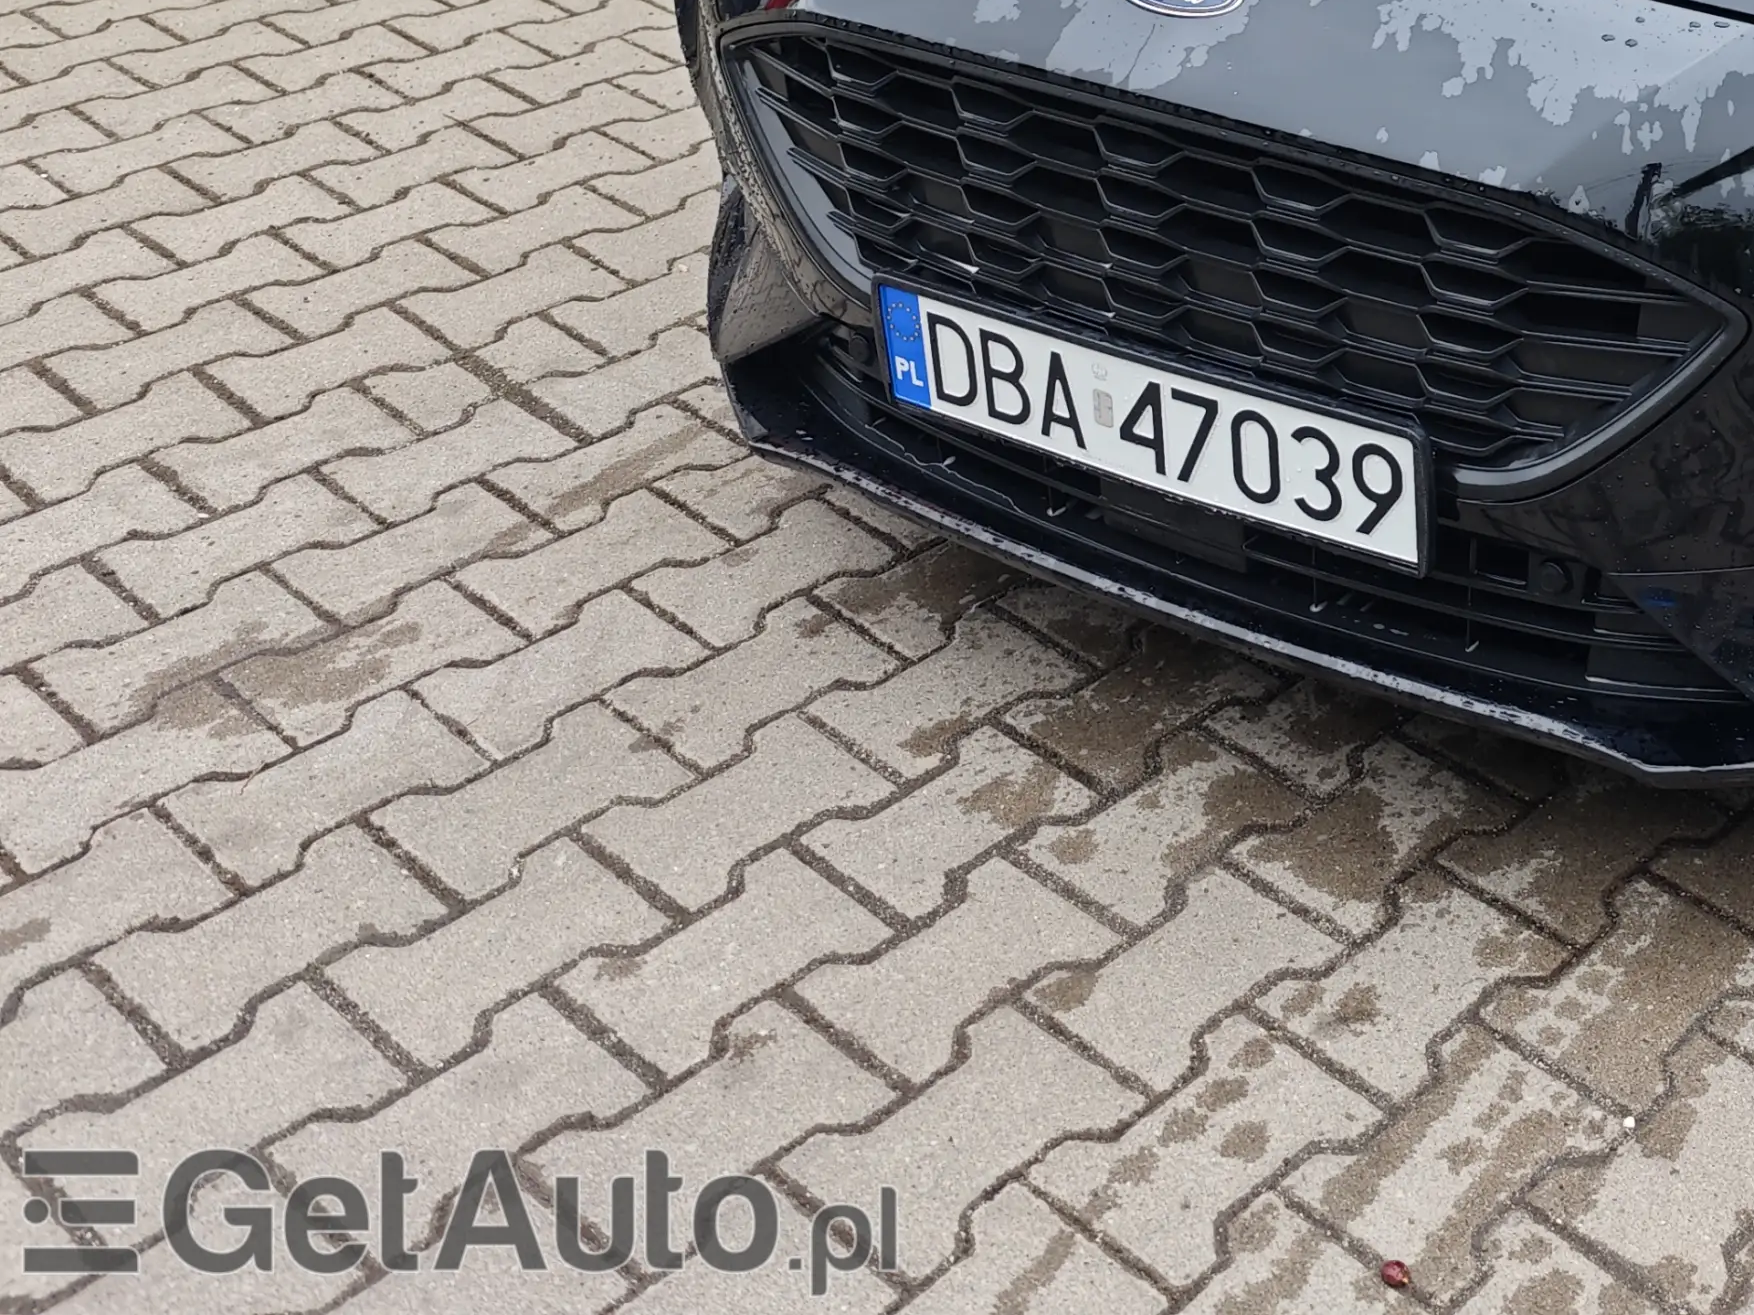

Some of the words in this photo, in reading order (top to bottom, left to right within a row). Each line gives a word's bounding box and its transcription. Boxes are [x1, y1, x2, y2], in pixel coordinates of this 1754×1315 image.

[895, 355, 925, 388] PL
[925, 311, 1089, 452] DBA
[1118, 380, 1404, 537] 47039
